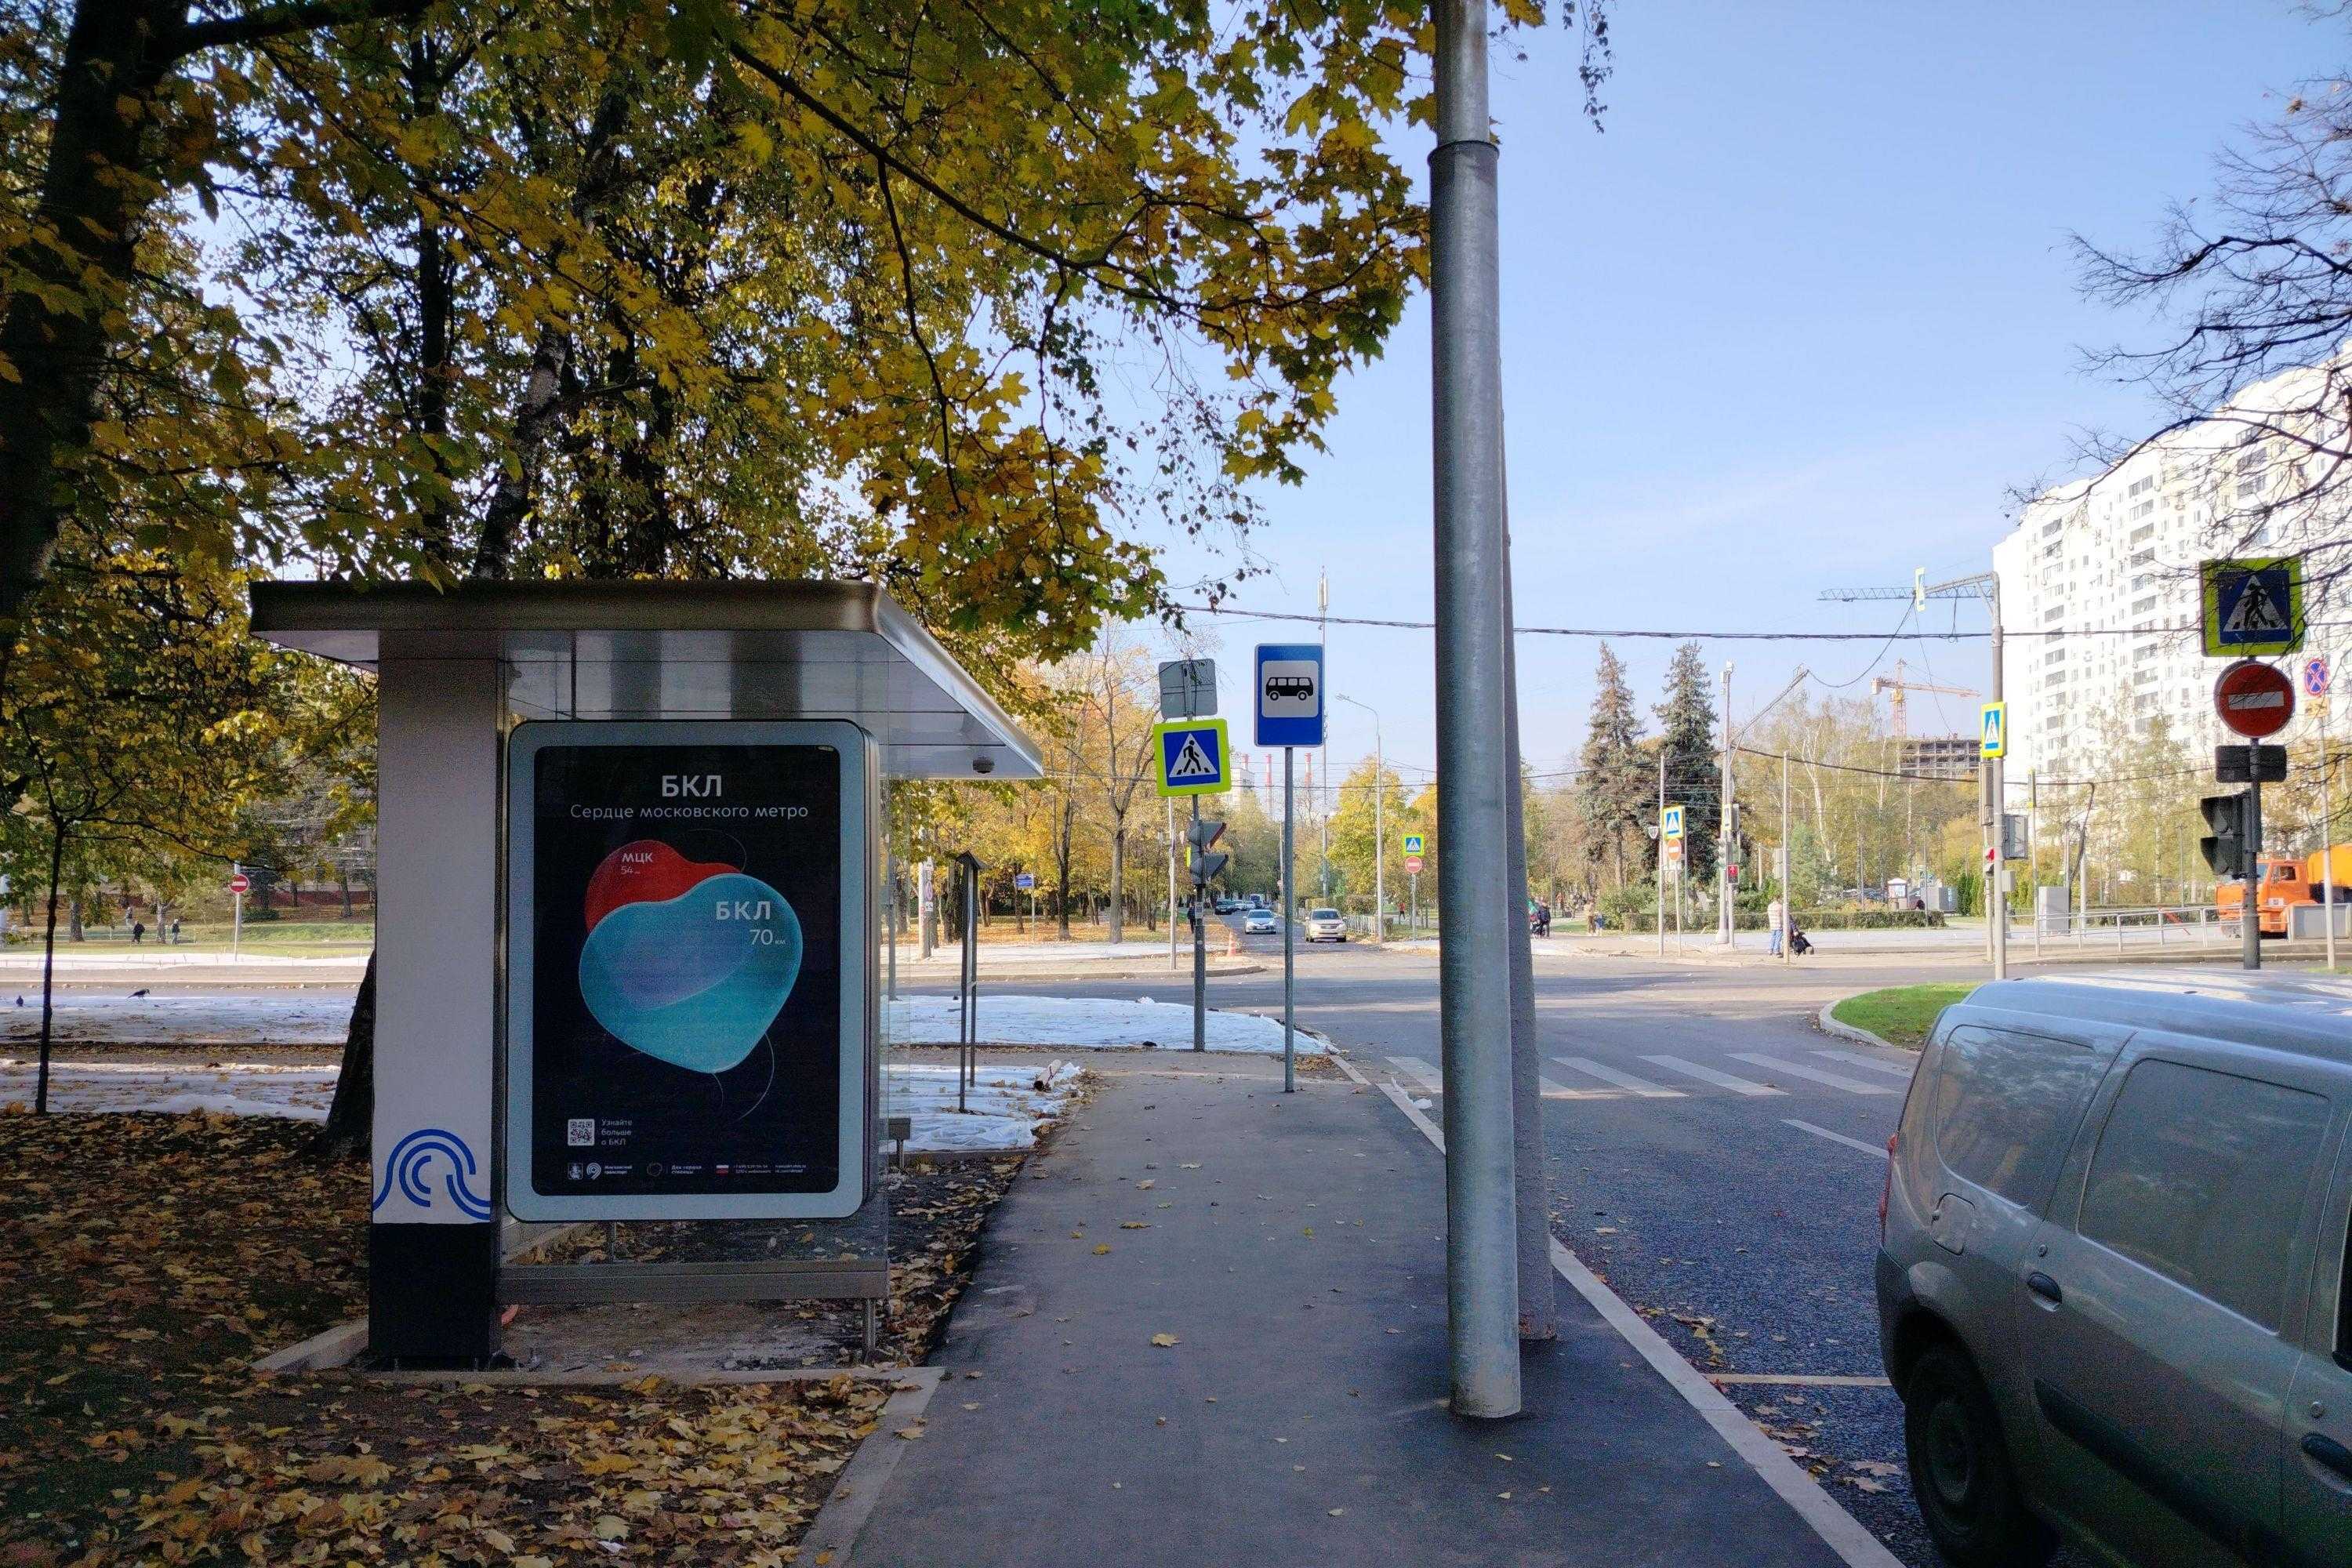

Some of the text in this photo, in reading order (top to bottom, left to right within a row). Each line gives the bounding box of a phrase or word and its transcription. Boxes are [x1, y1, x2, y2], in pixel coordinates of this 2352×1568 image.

[662, 775, 722, 797] БКЛ
[571, 804, 809, 819] Сердце московского метро
[622, 852, 653, 864] МЦК
[621, 866, 633, 875] 54
[716, 901, 771, 920] БКЛ
[750, 929, 774, 946] 70
[601, 1128, 632, 1137] больше
